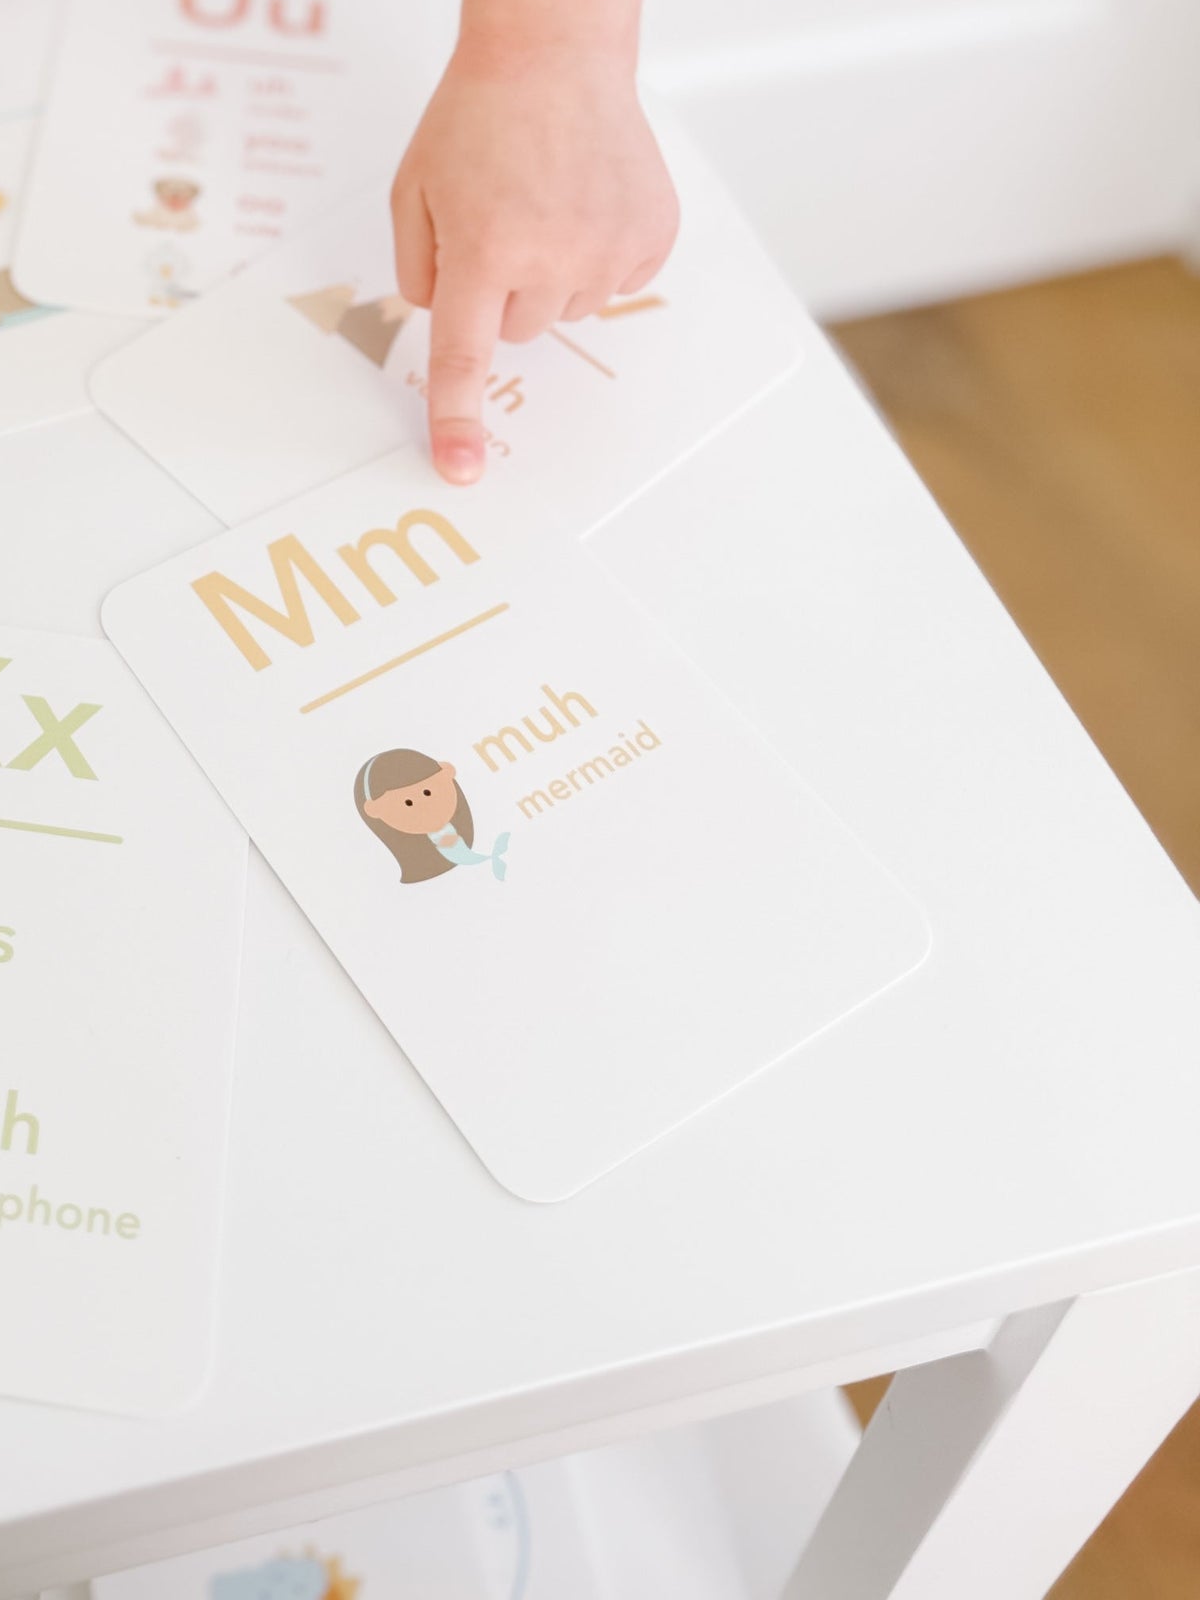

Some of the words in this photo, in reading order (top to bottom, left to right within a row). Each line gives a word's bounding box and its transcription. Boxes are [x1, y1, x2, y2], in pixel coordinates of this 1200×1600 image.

[189, 507, 481, 672] Mm
[472, 684, 599, 773] muh
[515, 718, 662, 820] mermaid
